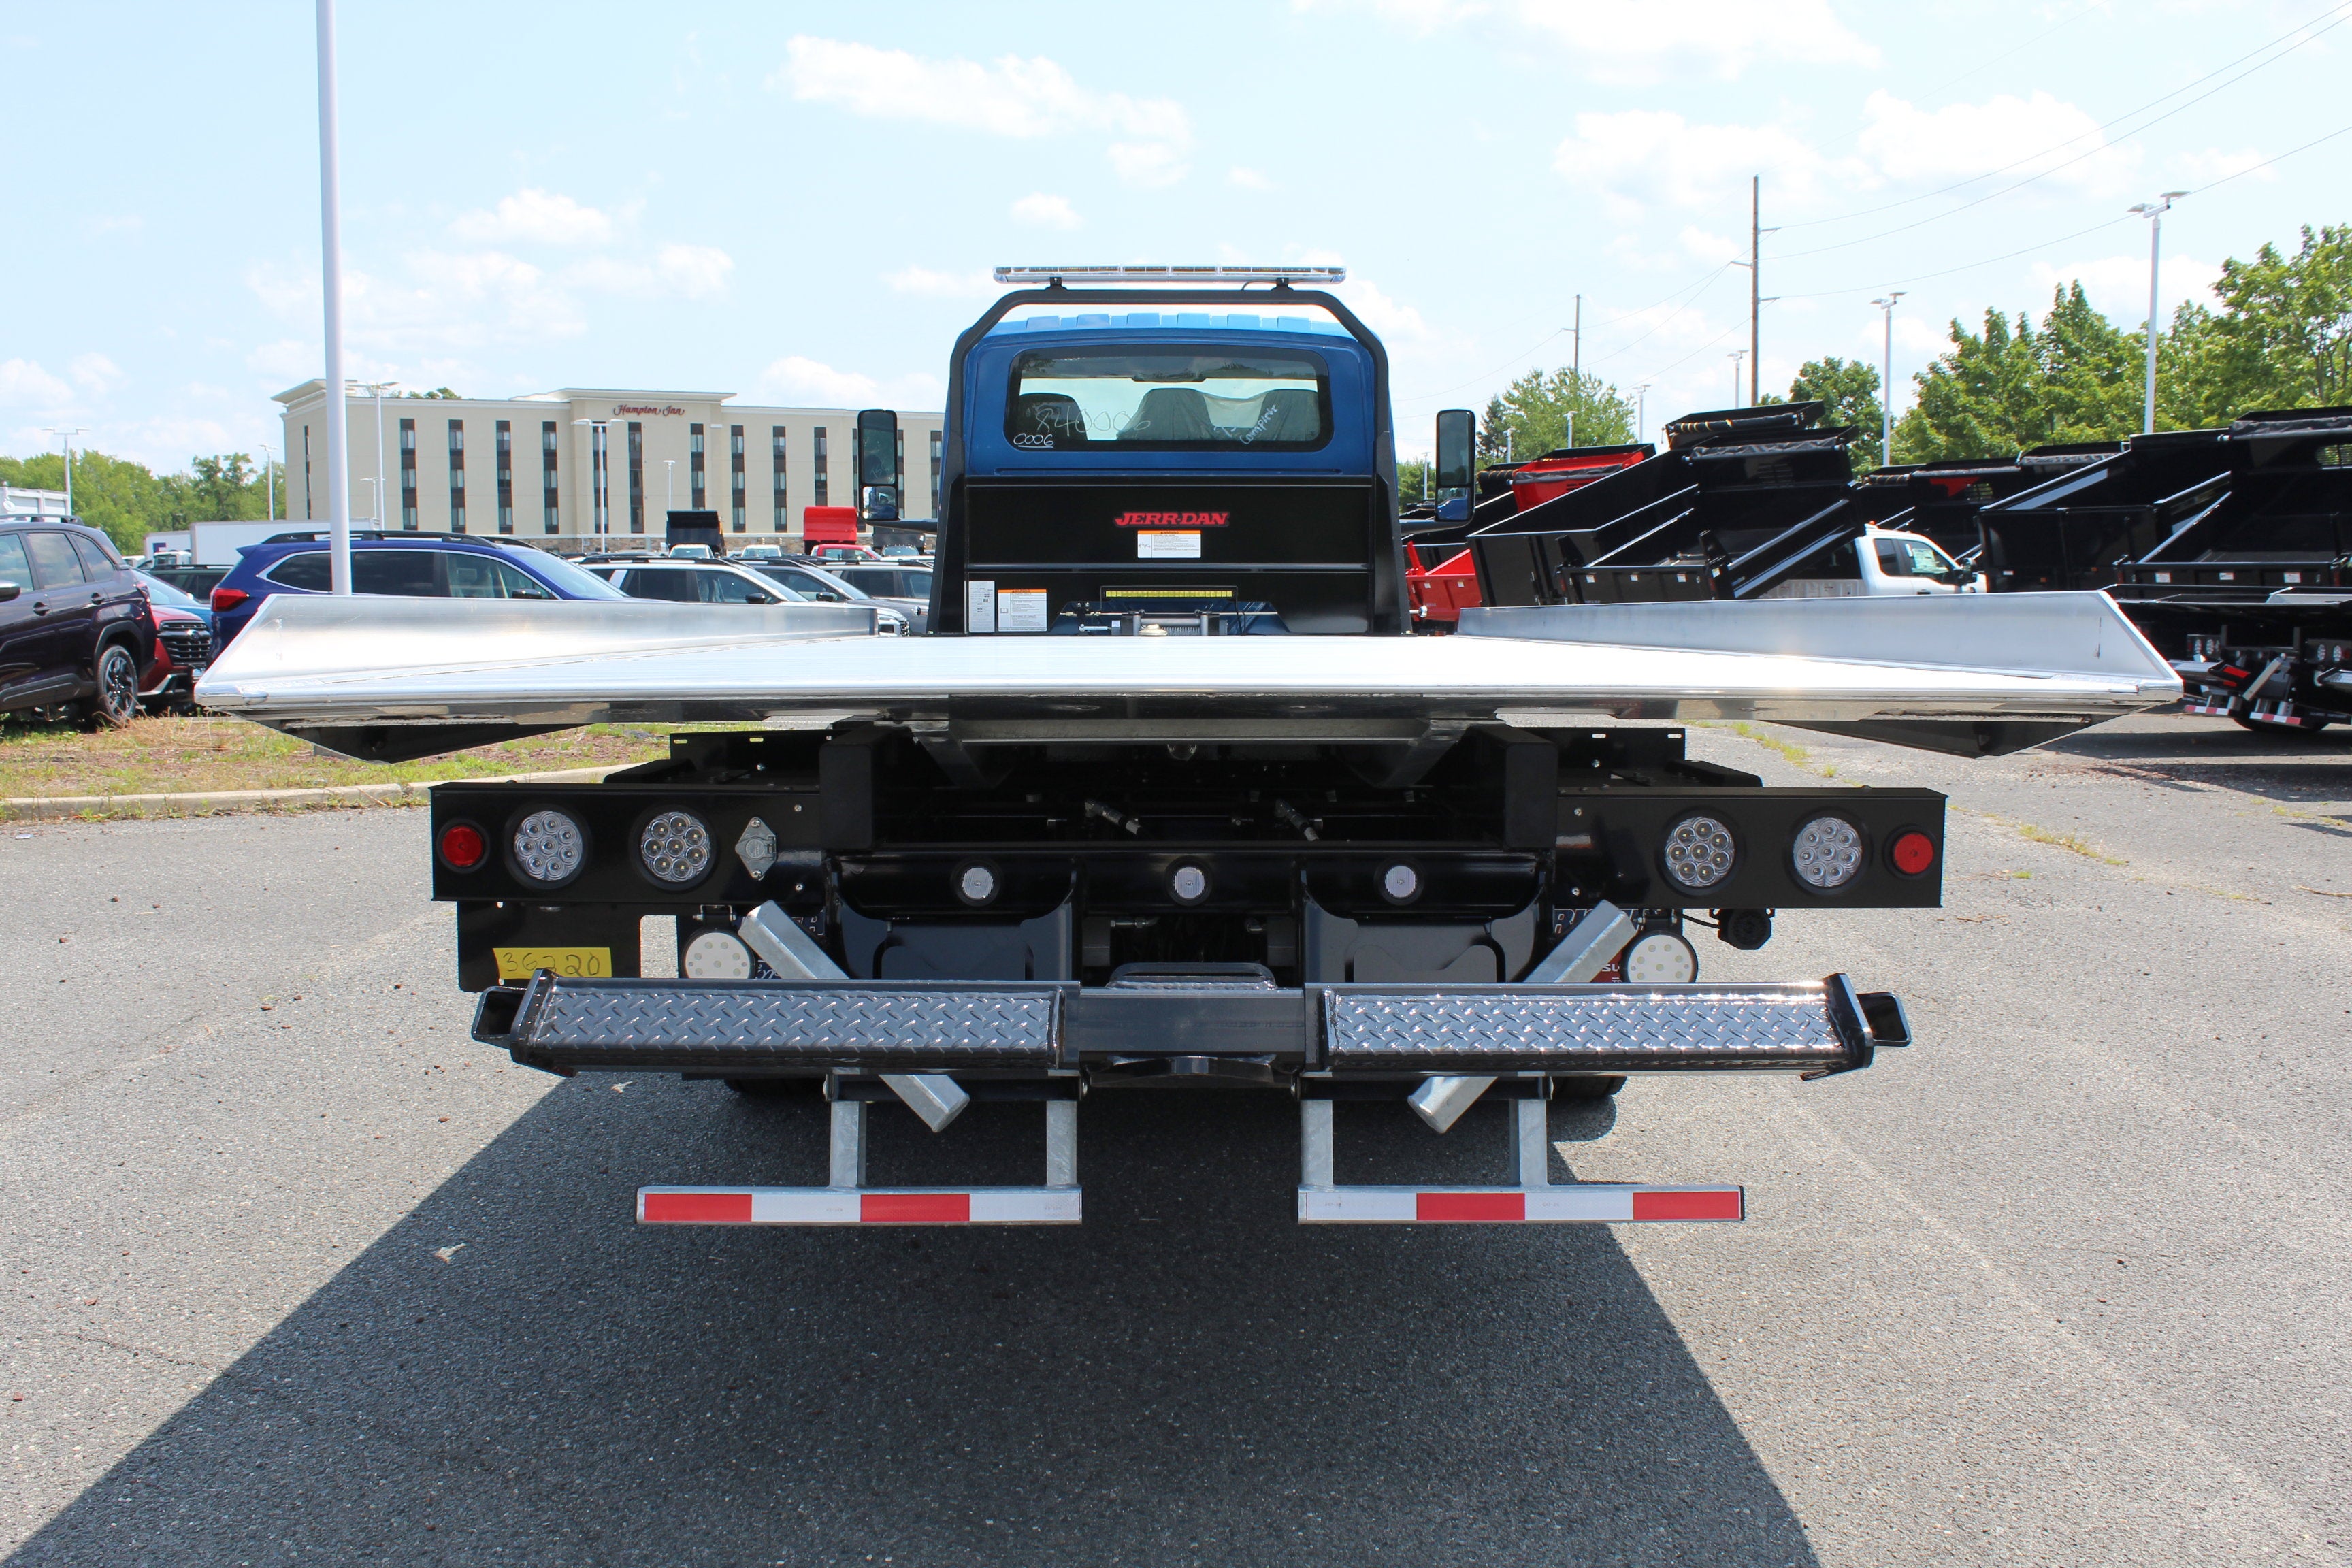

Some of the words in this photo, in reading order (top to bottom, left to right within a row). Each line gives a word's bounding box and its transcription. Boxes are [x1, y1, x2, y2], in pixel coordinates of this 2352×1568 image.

[613, 404, 661, 416] Hampton
[662, 405, 685, 416] Inn
[1013, 432, 1054, 446] 0006
